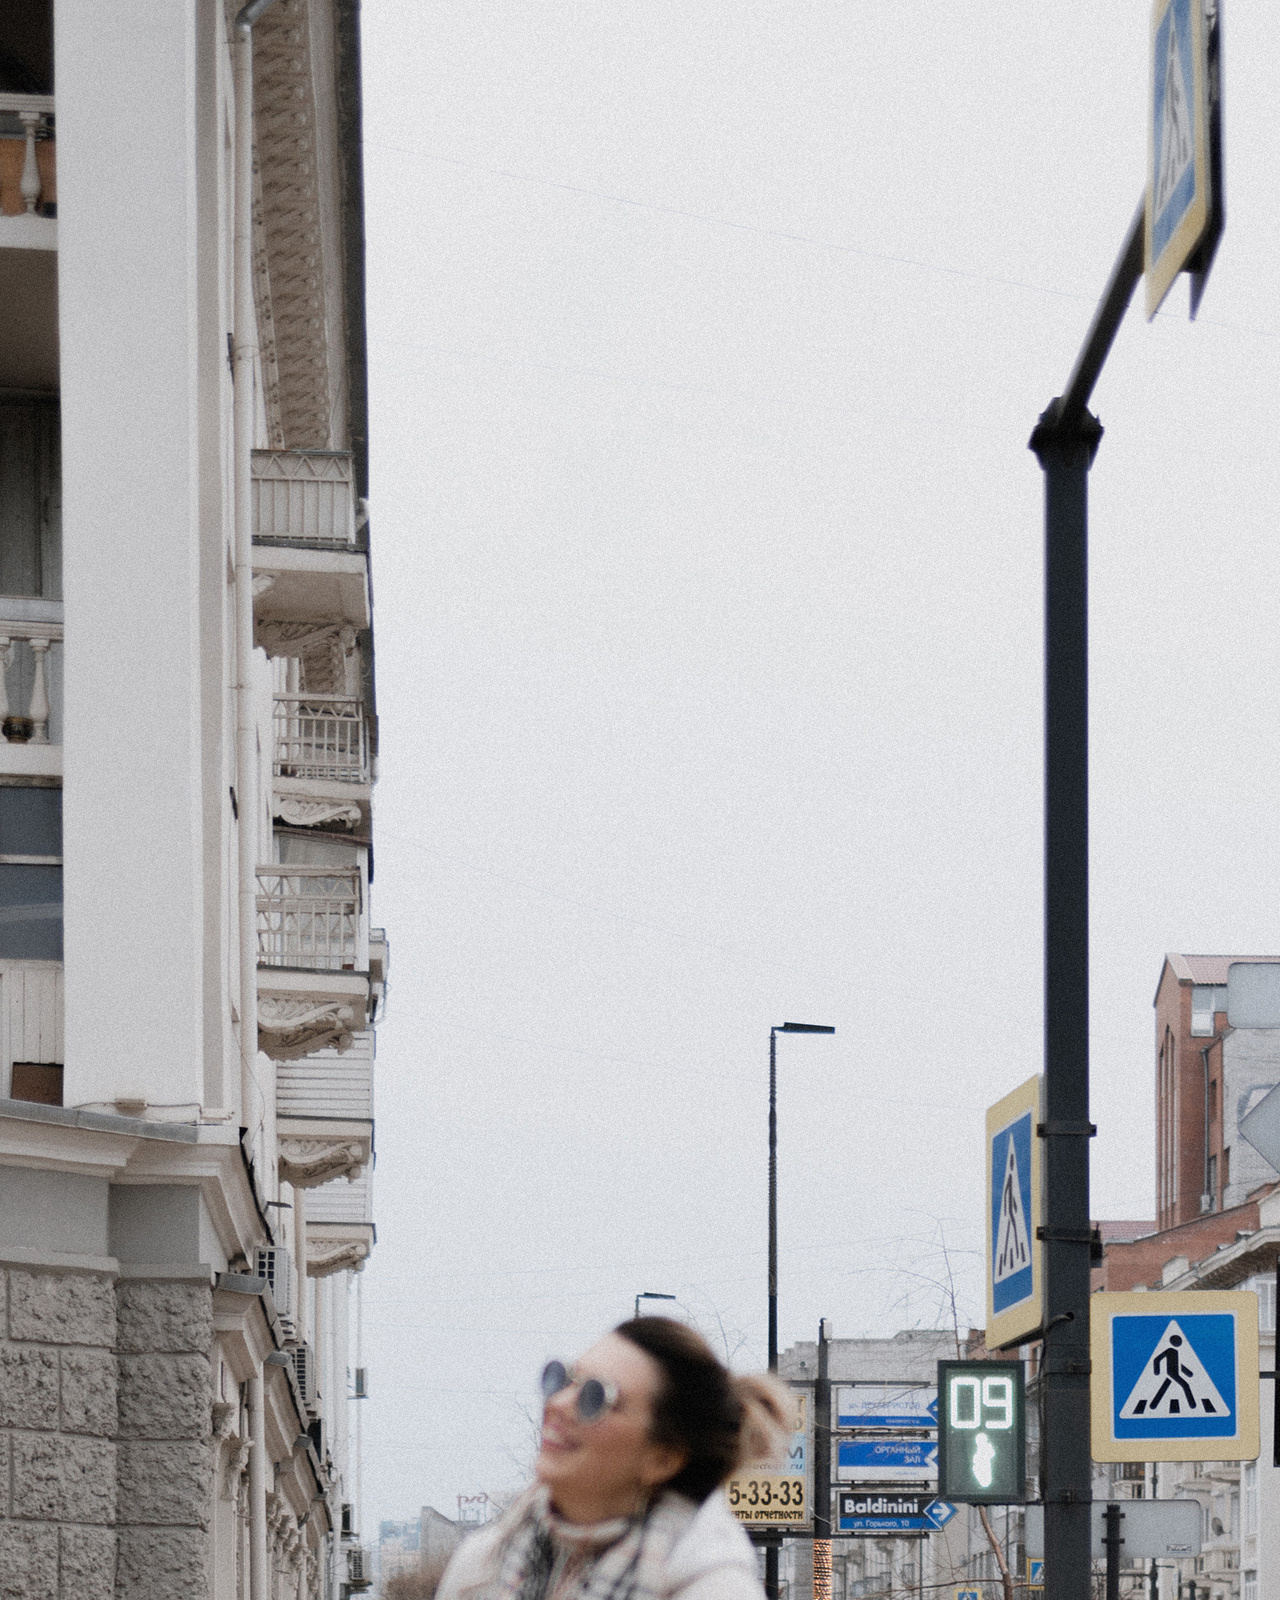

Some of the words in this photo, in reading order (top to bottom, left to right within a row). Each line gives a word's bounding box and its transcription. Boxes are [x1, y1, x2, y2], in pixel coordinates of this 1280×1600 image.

[950, 1376, 1013, 1429] 09
[874, 1445, 921, 1454] ОРГАННЫЙ
[904, 1456, 921, 1464] ЗАЛ
[844, 1497, 919, 1514] Baldinini
[755, 1510, 804, 1520] отчетности
[901, 1519, 910, 1527] 10
